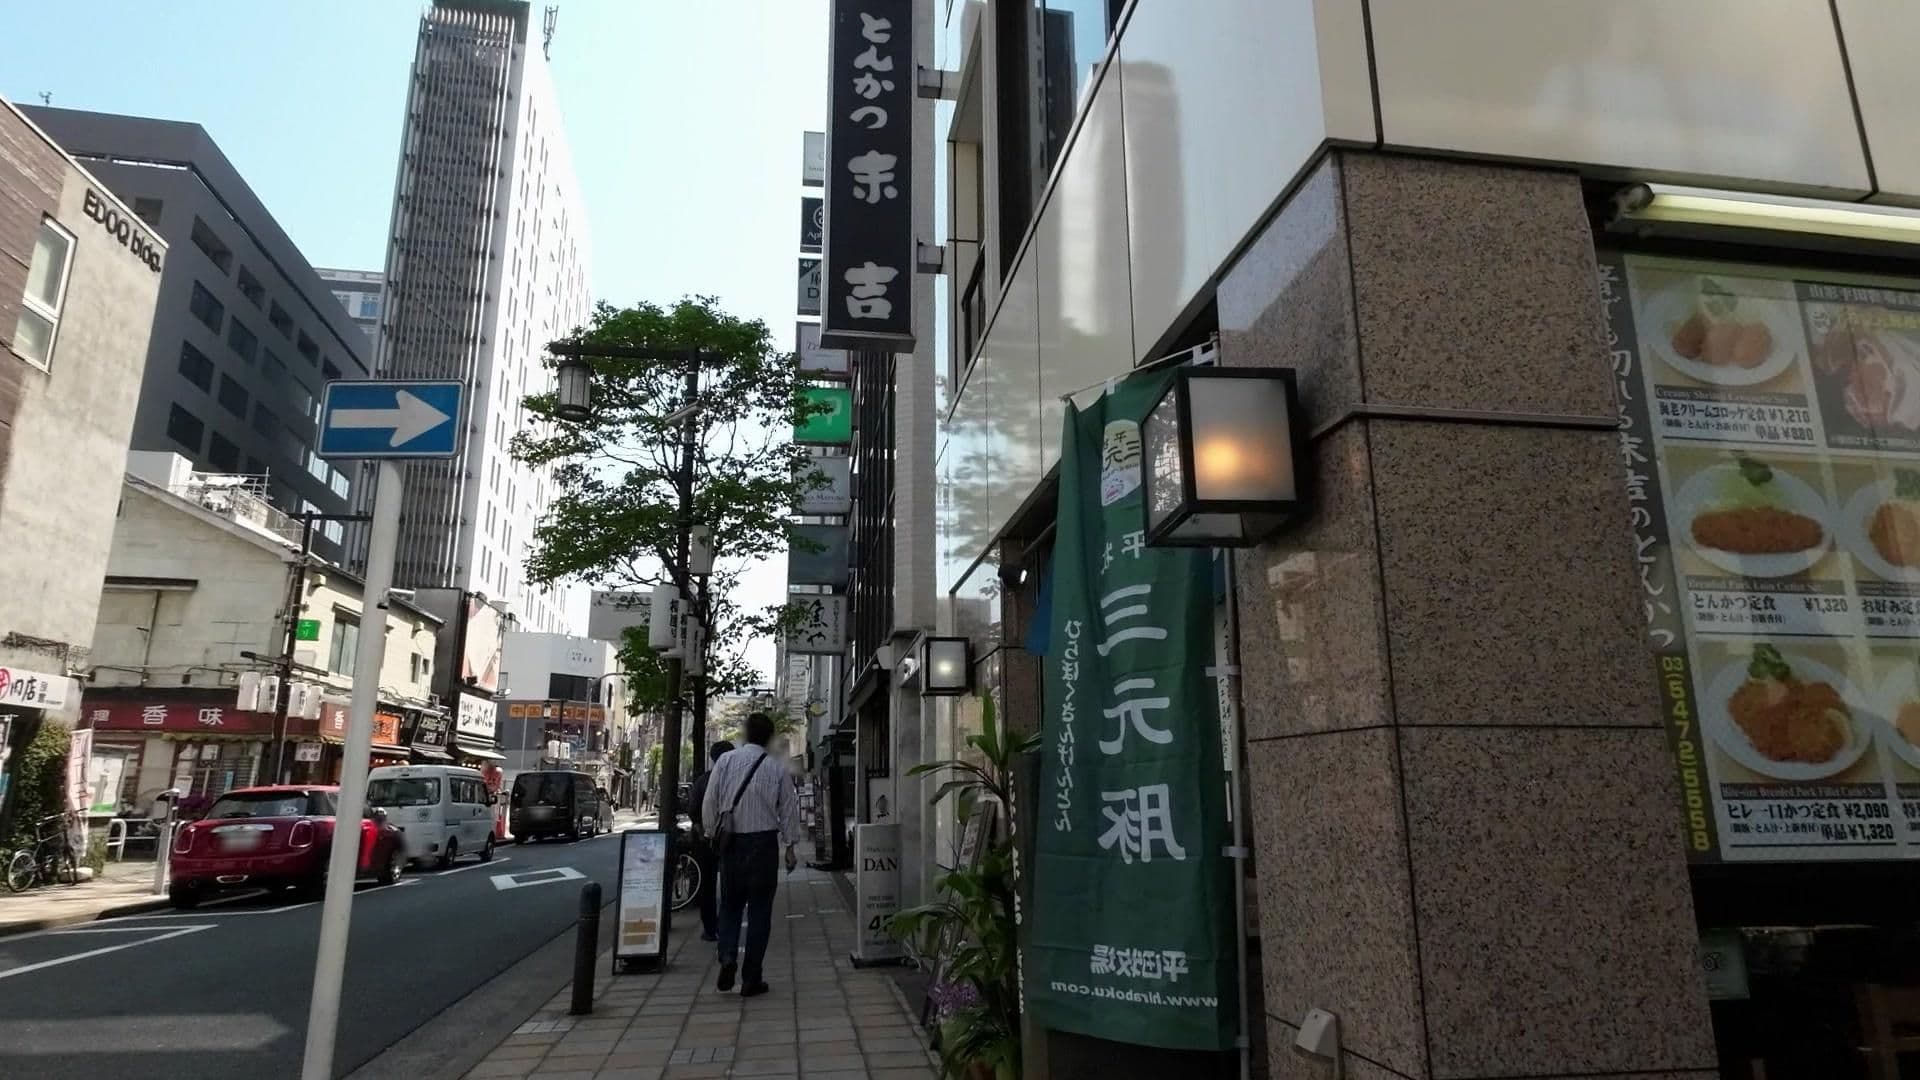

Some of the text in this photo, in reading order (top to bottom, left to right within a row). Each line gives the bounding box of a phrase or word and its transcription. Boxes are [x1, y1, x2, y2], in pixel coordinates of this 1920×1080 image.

[849, 12, 895, 129] とんかつ
[1694, 593, 1849, 613] とんかつ定食 ¥1,320
[142, 705, 224, 726] 香味
[1848, 824, 1895, 841] ¥1,320
[863, 857, 898, 872] DAN
